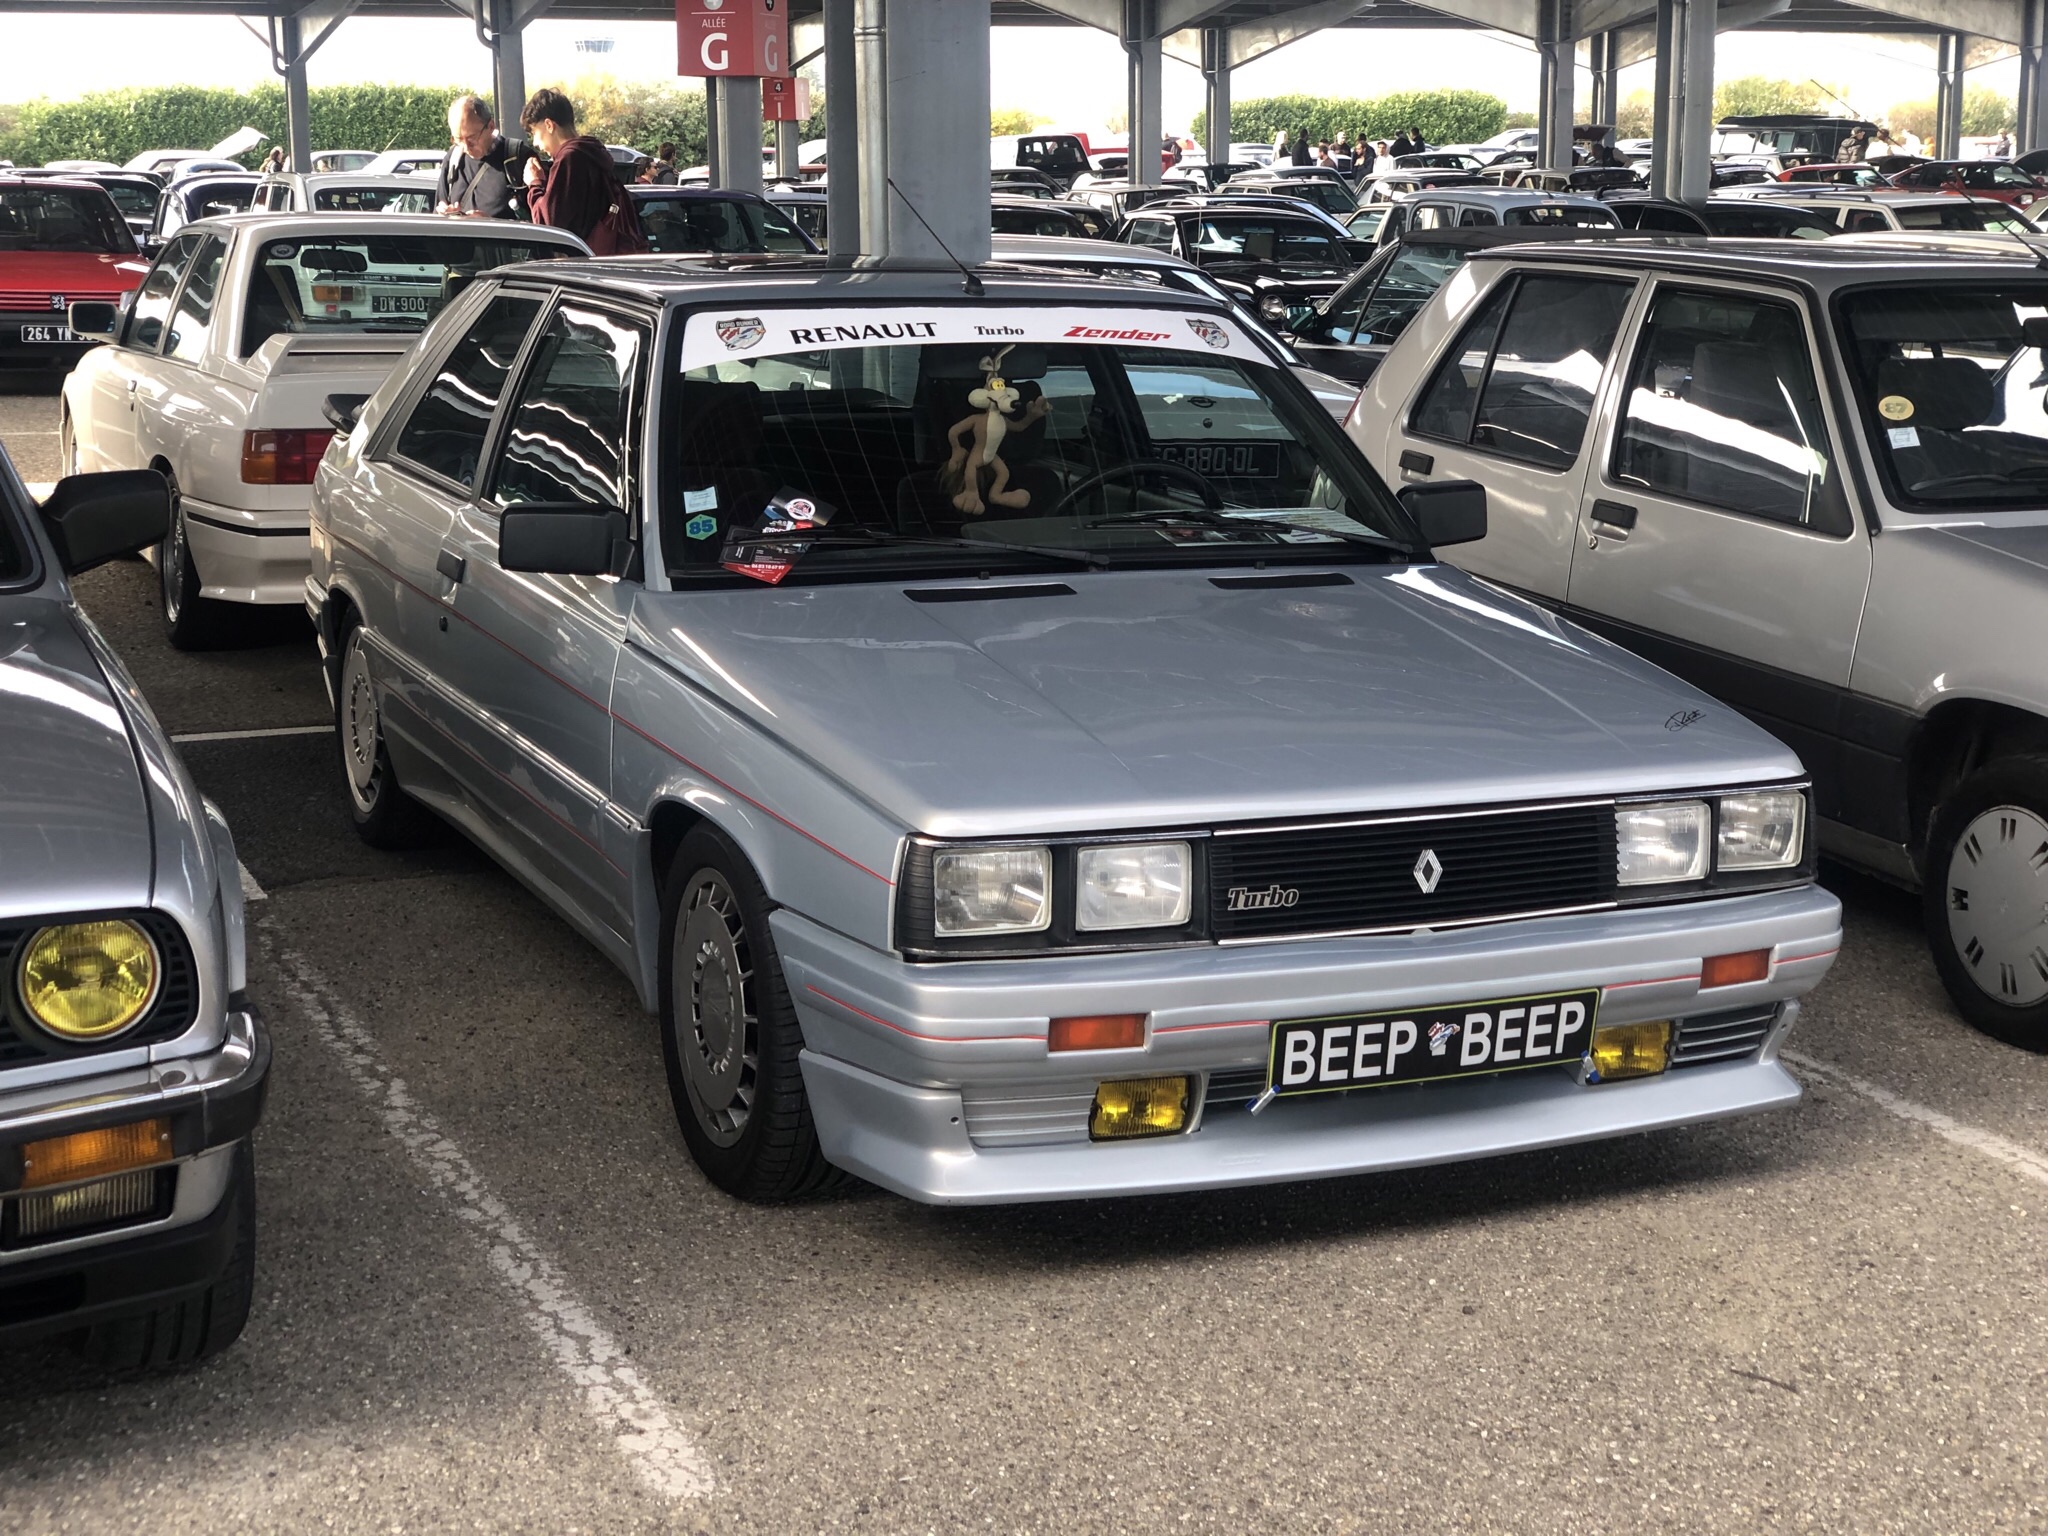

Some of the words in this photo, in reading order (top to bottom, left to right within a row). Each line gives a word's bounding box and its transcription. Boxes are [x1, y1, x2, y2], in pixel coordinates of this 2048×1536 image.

[701, 16, 726, 28] ALLÉE
[701, 32, 729, 71] G
[764, 34, 778, 72] G
[775, 83, 782, 92] 4
[719, 321, 735, 329] ROAD
[736, 319, 759, 328] RUNNER
[974, 325, 1025, 336] Turbo
[27, 327, 50, 341] 264
[789, 322, 937, 345] RENAULT
[1063, 326, 1172, 341] Zender
[1884, 402, 1907, 413] 87
[689, 519, 714, 535] 85
[1227, 884, 1300, 911] Turbo
[1282, 1020, 1418, 1085] BEEP
[1459, 1001, 1586, 1067] BEEP
